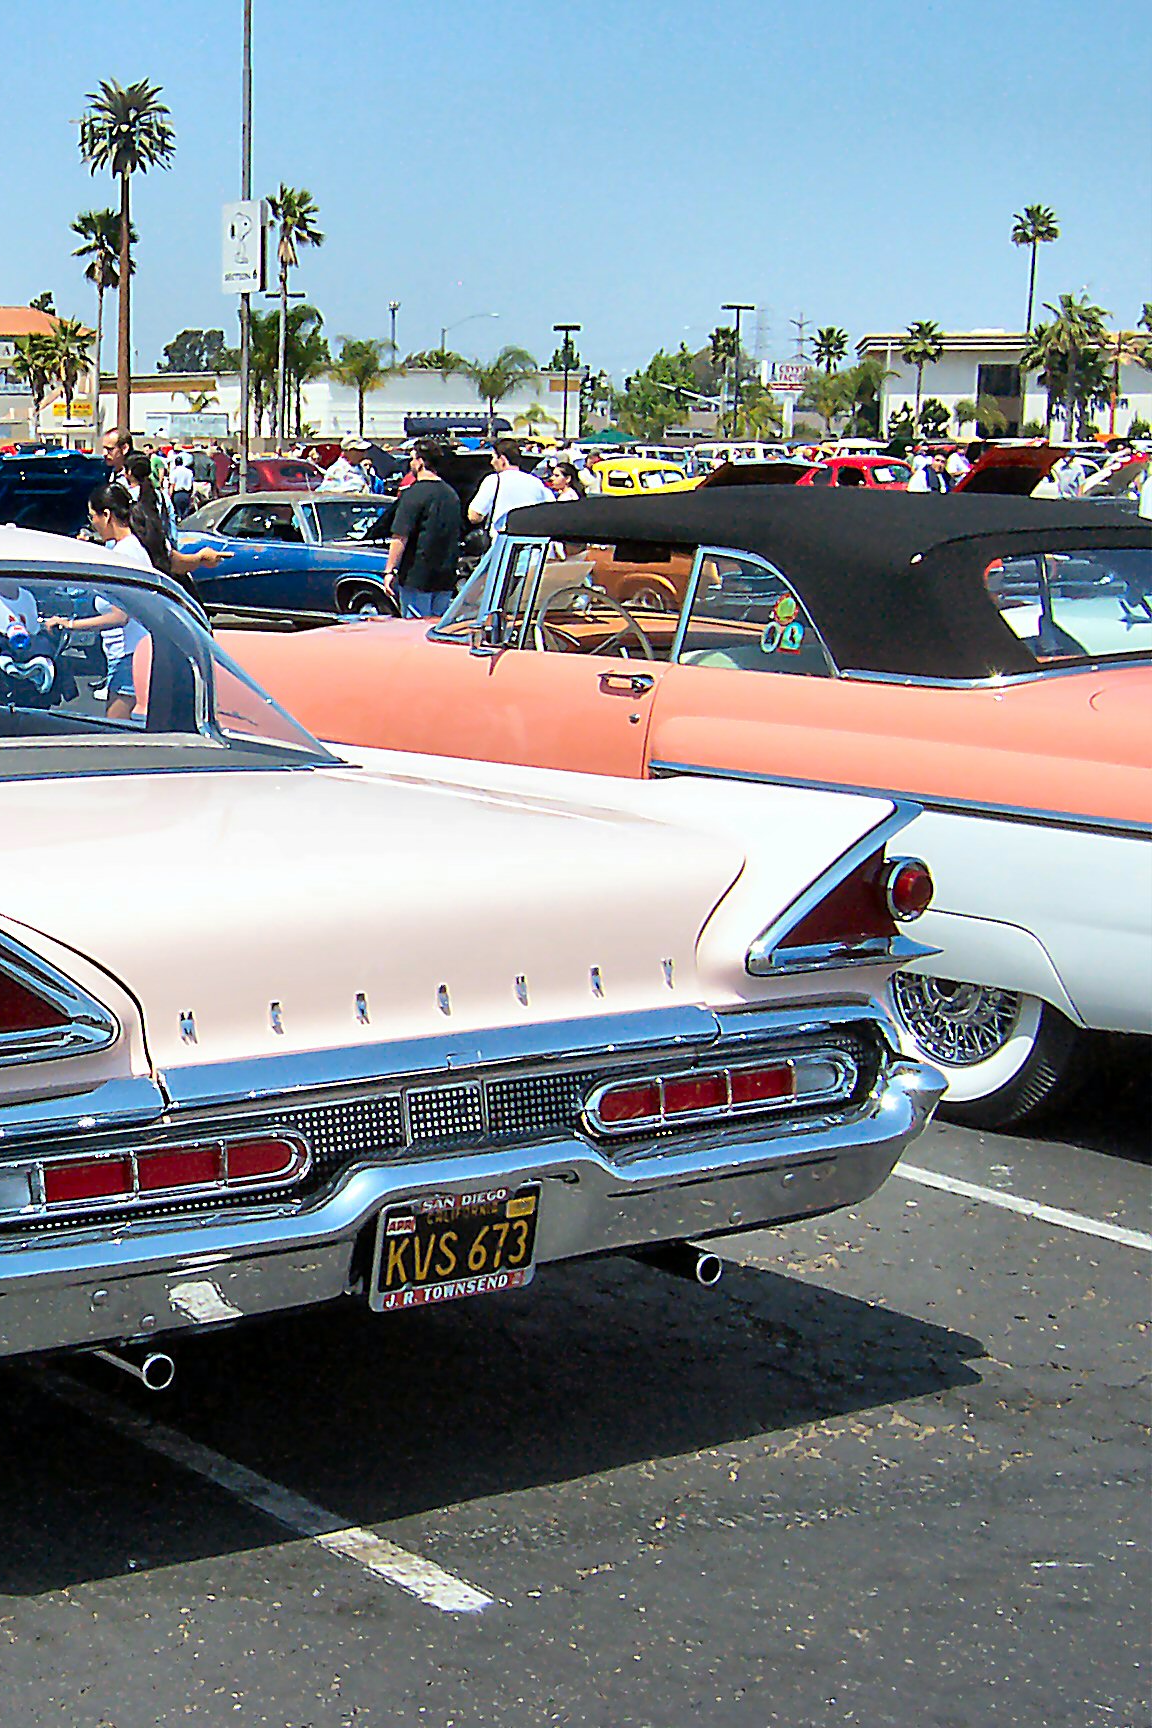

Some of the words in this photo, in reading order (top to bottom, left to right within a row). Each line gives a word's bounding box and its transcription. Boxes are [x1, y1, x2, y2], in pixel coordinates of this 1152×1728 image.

[422, 1194, 456, 1211] SAN
[461, 1188, 507, 1206] DIEGO
[385, 1231, 458, 1287] KVS
[468, 1219, 529, 1271] 673
[385, 1294, 399, 1308] J.
[403, 1290, 418, 1305] R.
[423, 1274, 508, 1301] TOWNSEND
